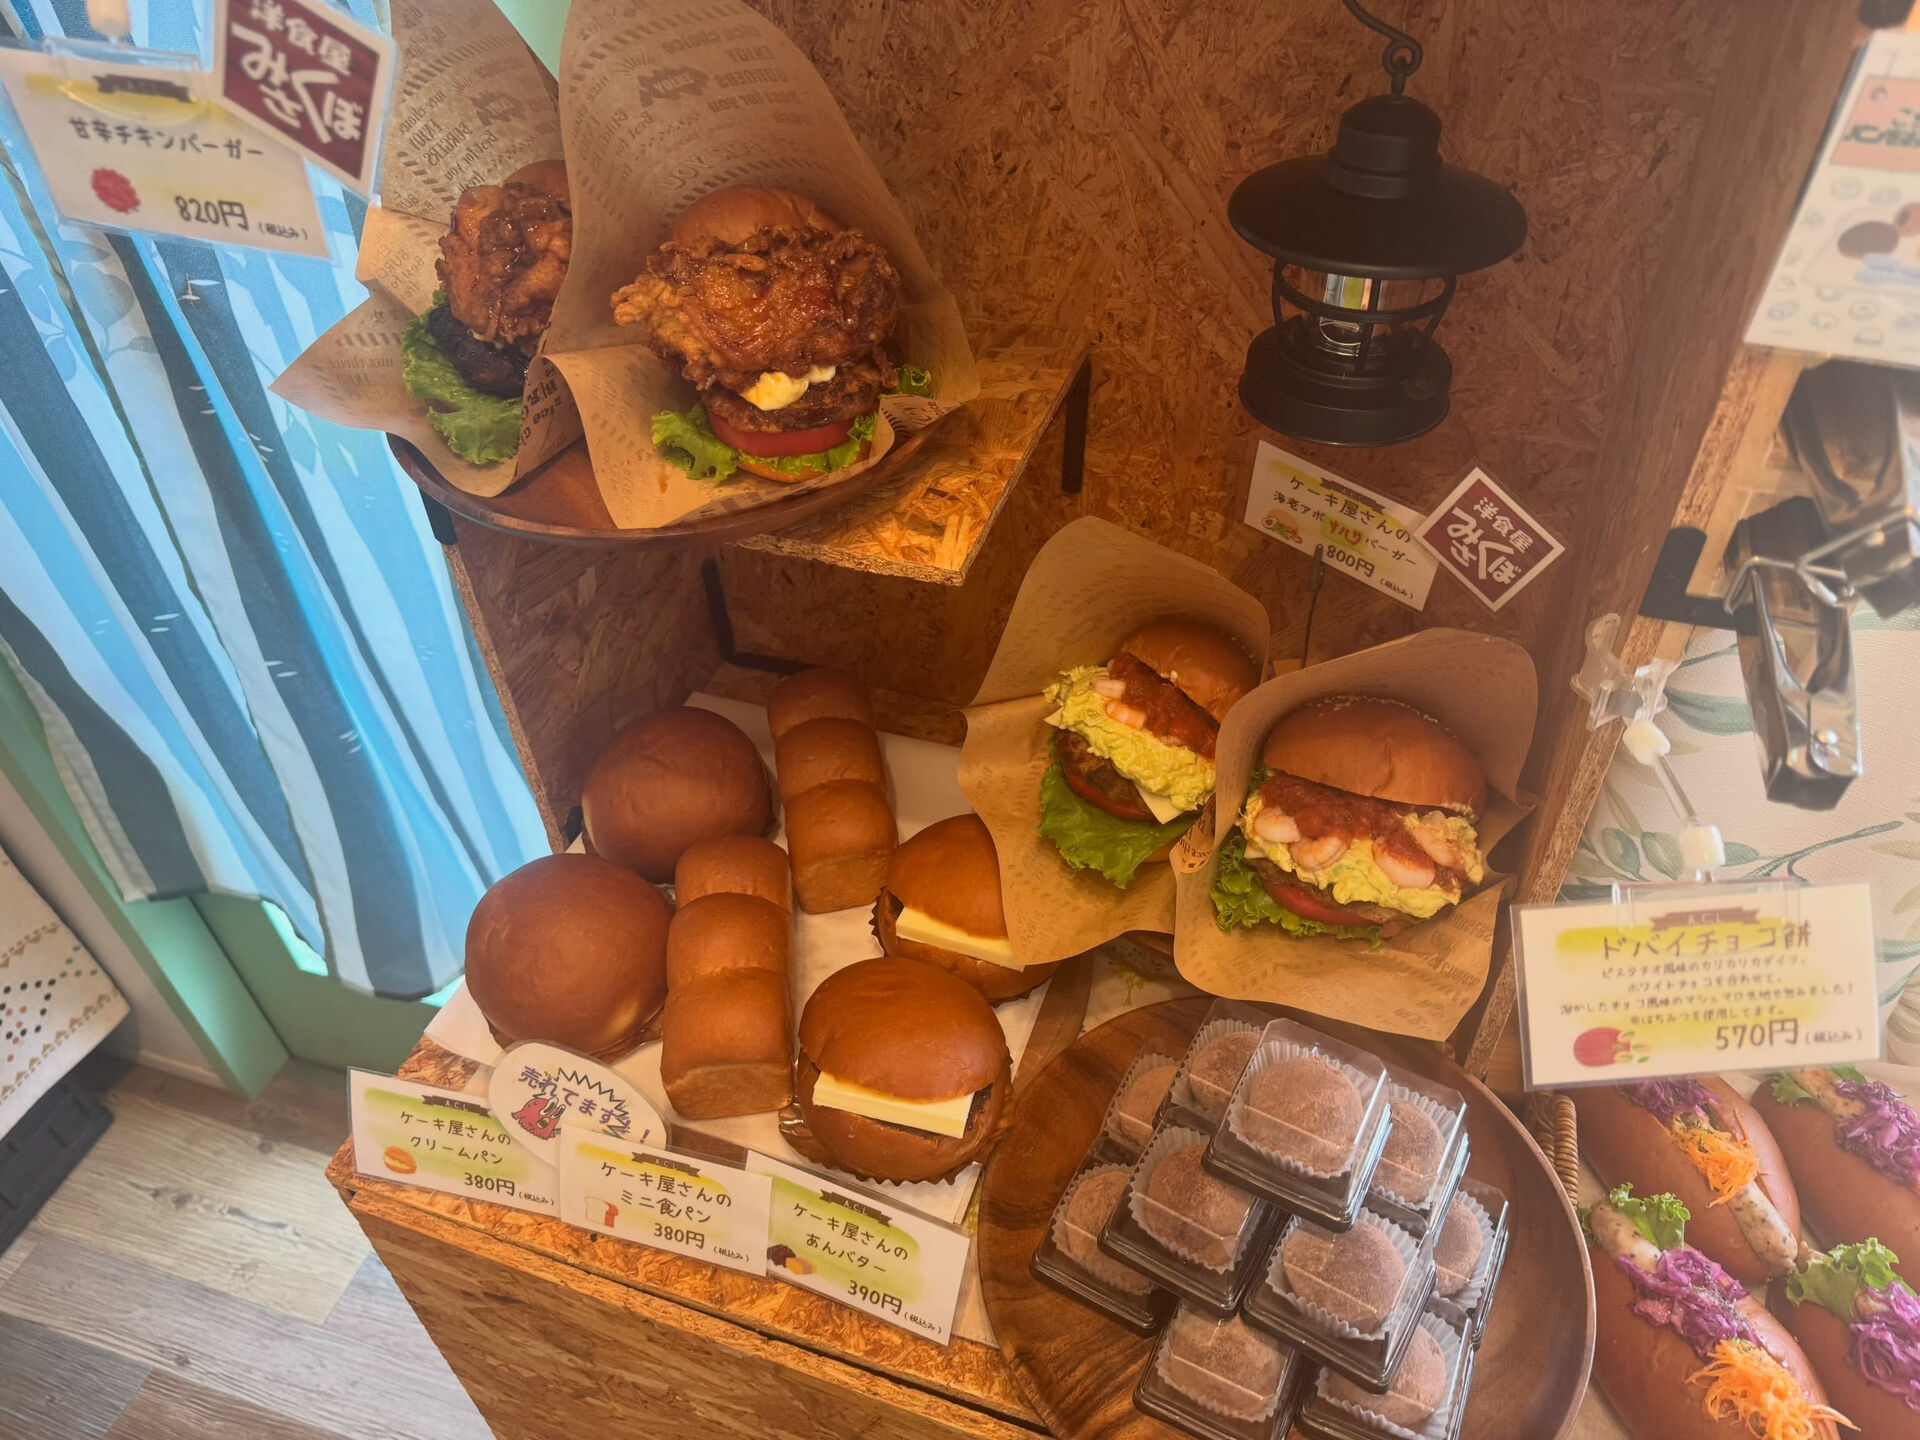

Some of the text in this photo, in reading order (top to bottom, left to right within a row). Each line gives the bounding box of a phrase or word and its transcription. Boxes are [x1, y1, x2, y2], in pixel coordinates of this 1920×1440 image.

[175, 194, 249, 230] 820円
[1290, 477, 1411, 543] ケーキ屋さんの
[1473, 497, 1534, 554] 洋食屋
[1326, 544, 1375, 578] 800円
[1602, 920, 1812, 959] ドバイチョコ餅
[1716, 1016, 1799, 1050] 570円
[400, 1111, 512, 1145] ケーキ屋さんの
[410, 1136, 503, 1164] クリームパン
[463, 1171, 516, 1197] 380円
[601, 1162, 732, 1208] ケーキ屋さんの
[621, 1189, 711, 1223] ミニ食パン
[654, 1222, 705, 1250] 380円
[793, 1203, 909, 1260] ケーキ屋さんの
[805, 1233, 886, 1273] あんバター
[847, 1279, 903, 1315] 390円
